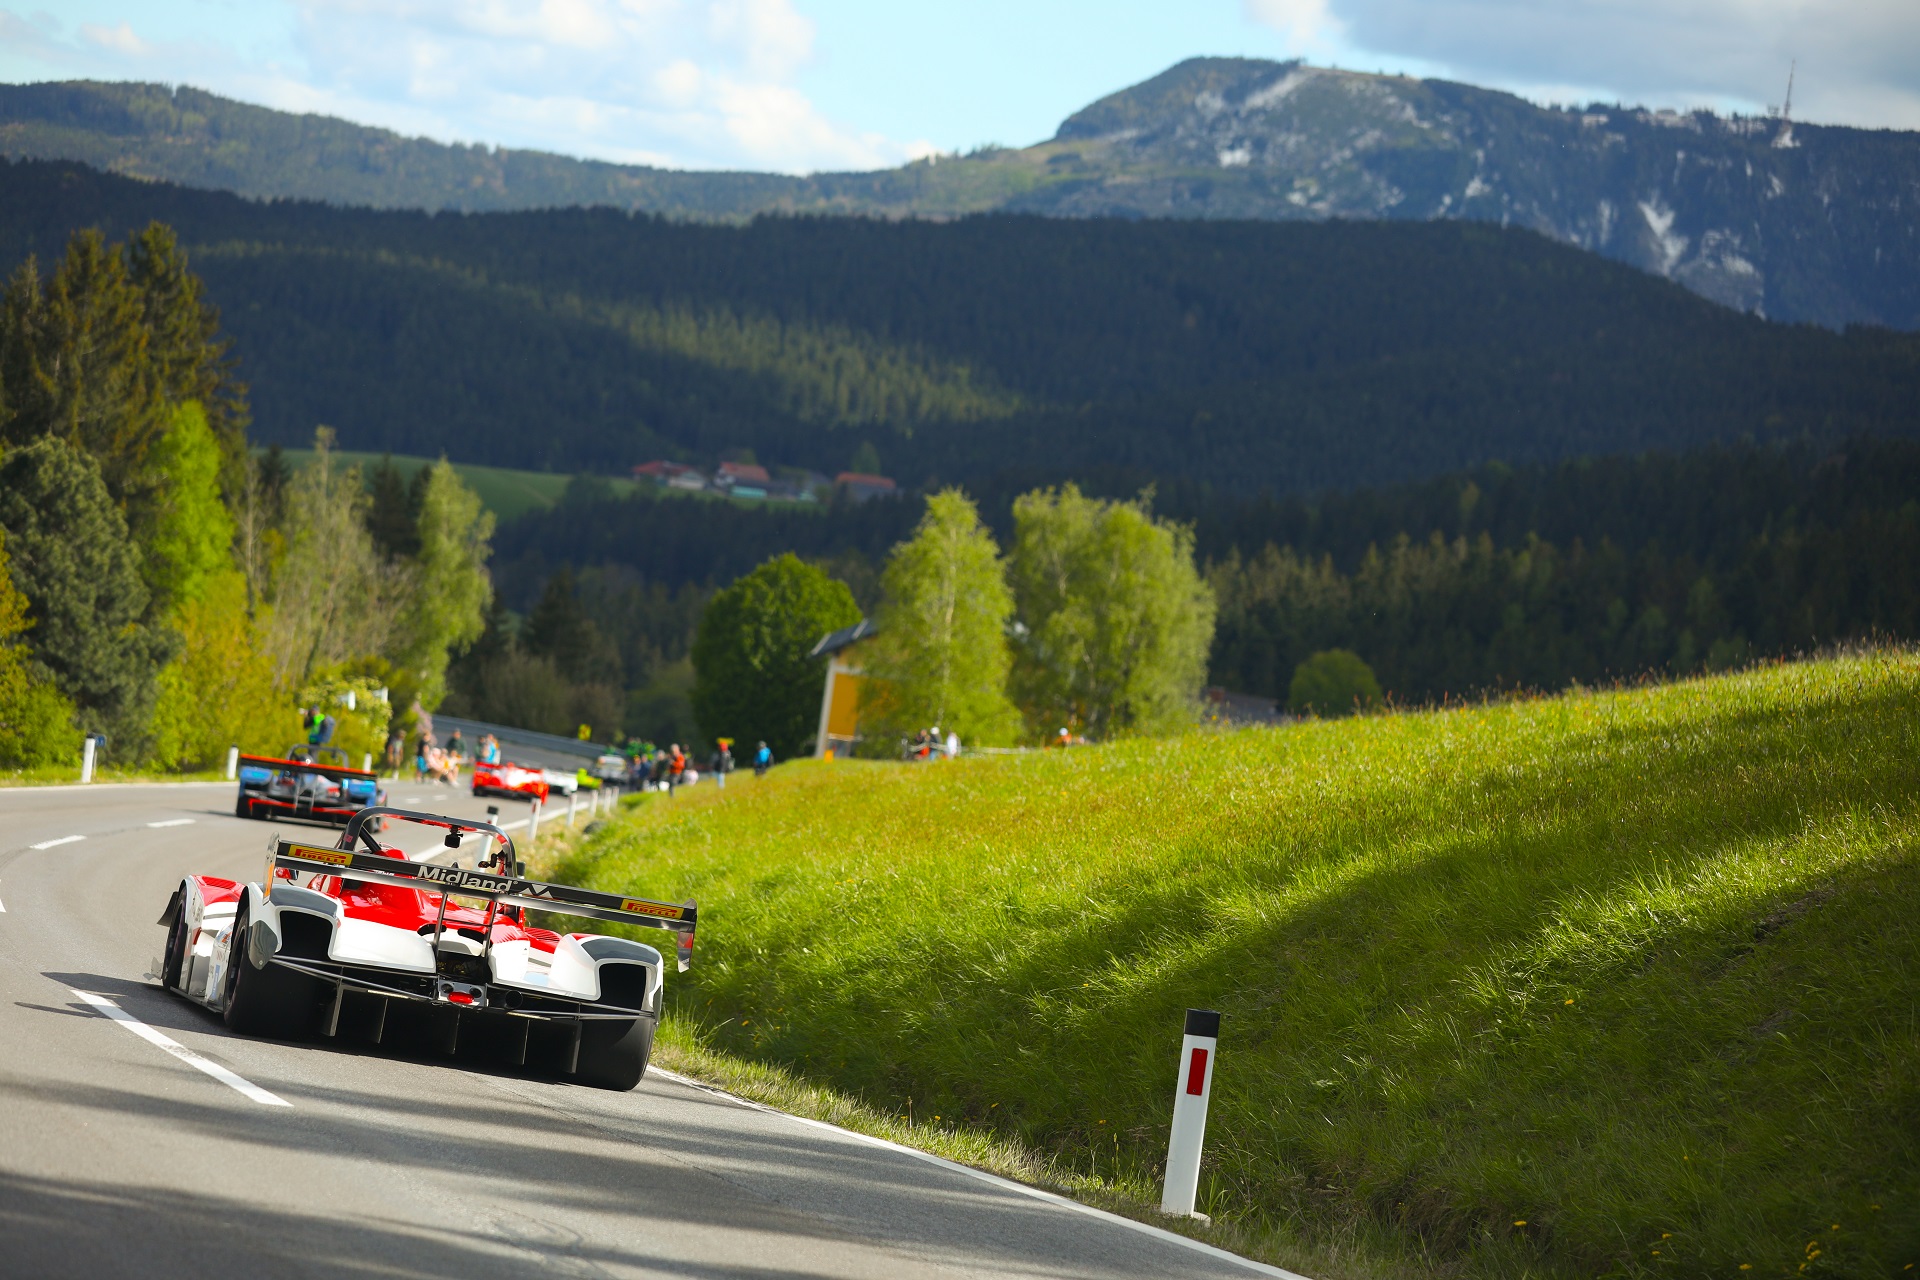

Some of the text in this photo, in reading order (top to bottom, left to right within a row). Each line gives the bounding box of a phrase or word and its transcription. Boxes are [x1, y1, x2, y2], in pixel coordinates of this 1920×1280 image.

[295, 848, 347, 864] PIRELLI
[417, 865, 513, 892] Midland
[627, 902, 678, 917] PIRELLI
